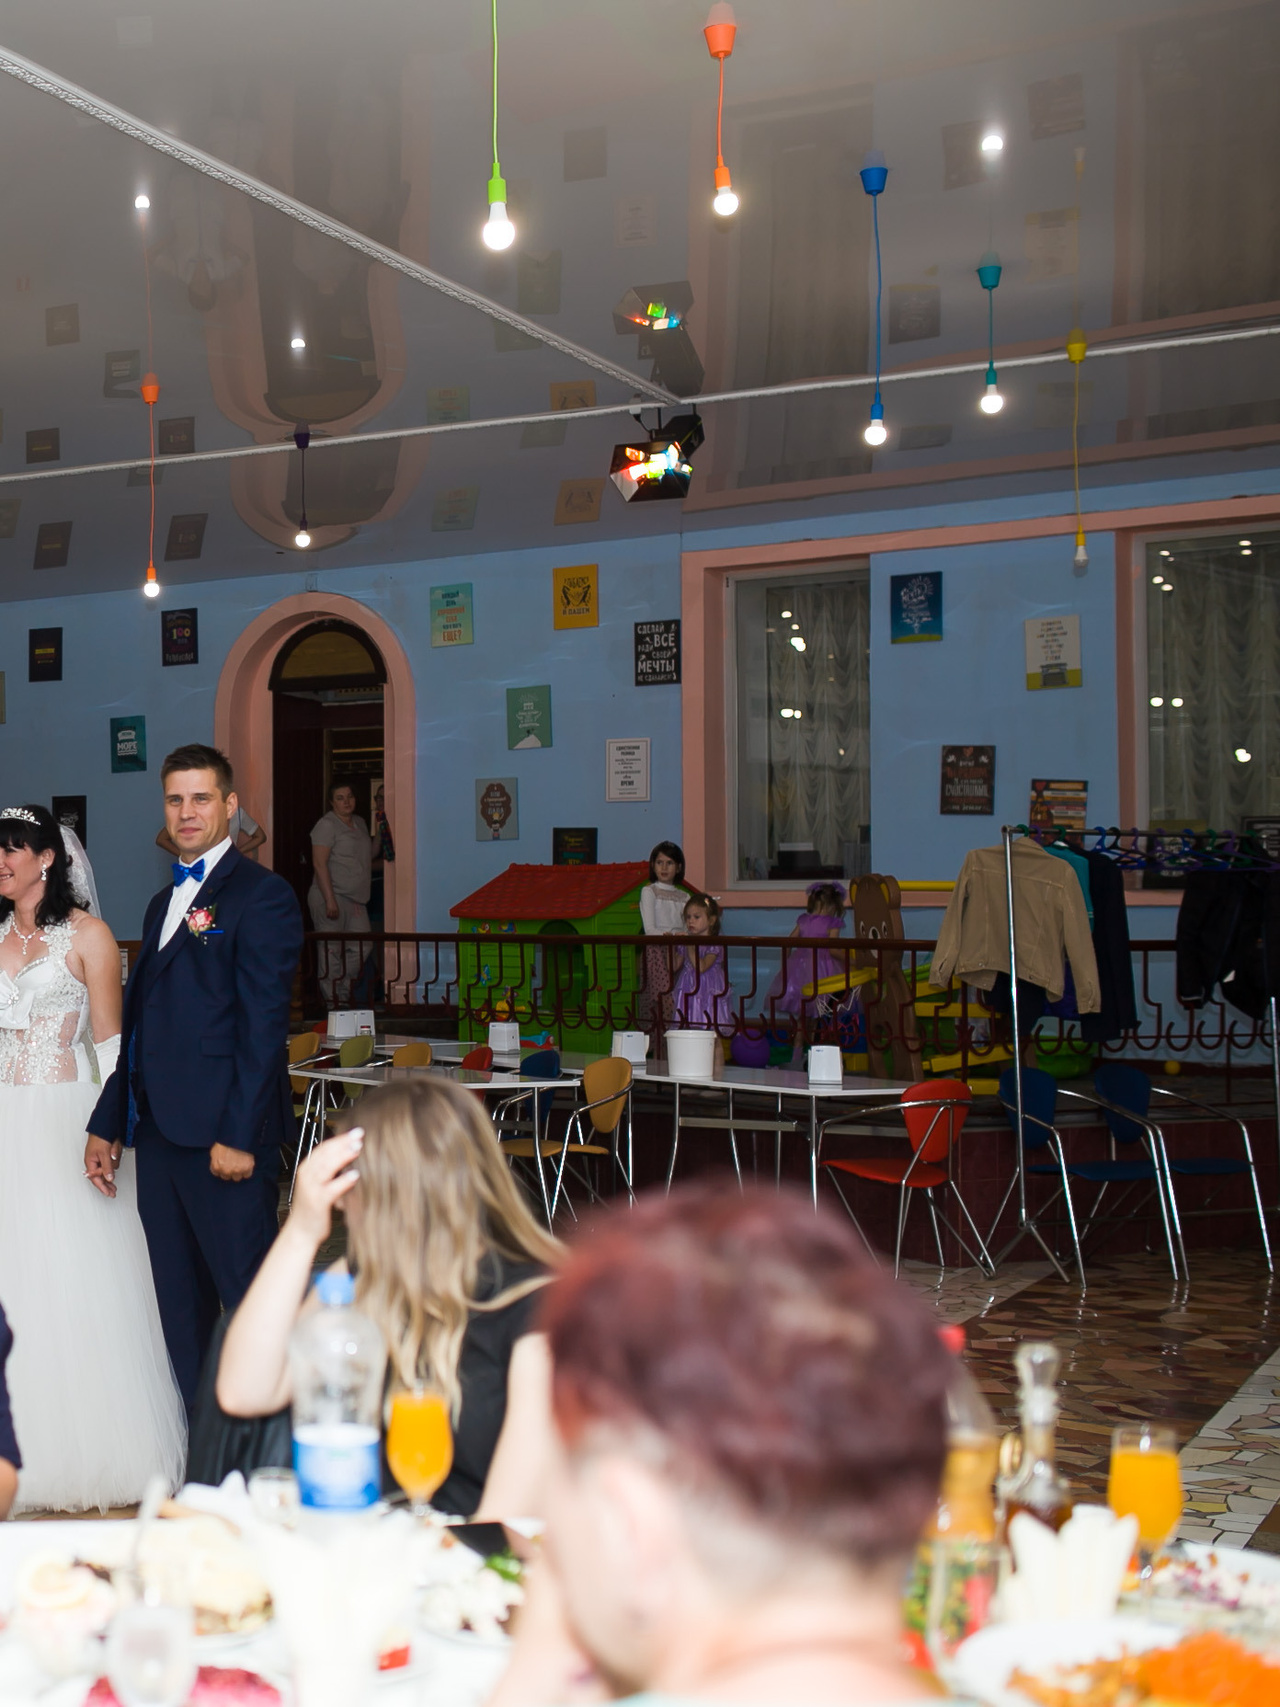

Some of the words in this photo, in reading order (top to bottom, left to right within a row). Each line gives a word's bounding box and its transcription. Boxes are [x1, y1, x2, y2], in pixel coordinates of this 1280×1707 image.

[172, 627, 191, 640] 100
[637, 622, 665, 634] СДЕЛАЙ
[638, 659, 675, 673] МЕЧТЫ
[117, 741, 138, 751] МОРЕ
